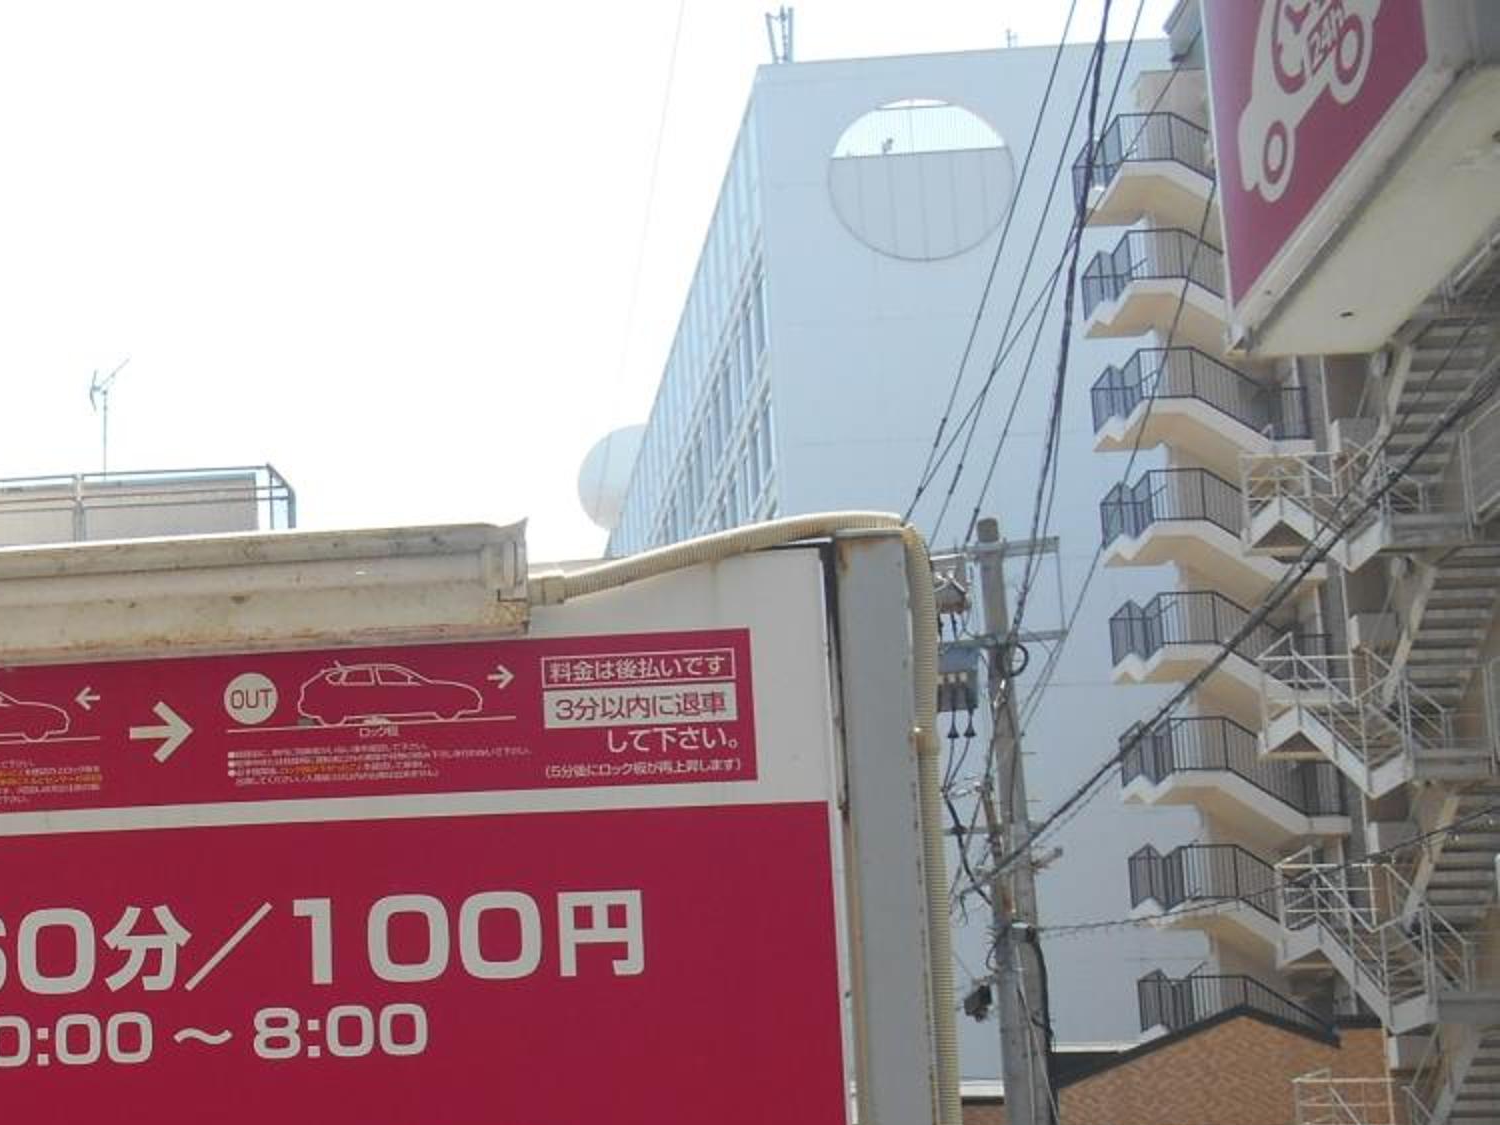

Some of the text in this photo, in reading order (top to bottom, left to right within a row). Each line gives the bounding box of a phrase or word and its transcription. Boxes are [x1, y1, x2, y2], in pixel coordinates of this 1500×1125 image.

[549, 655, 726, 682] 料金は後払いです
[230, 686, 273, 710] OUT
[555, 690, 728, 721] 3分以内に退車
[607, 727, 738, 754] して下さい。
[253, 1003, 430, 1060] 8:00
